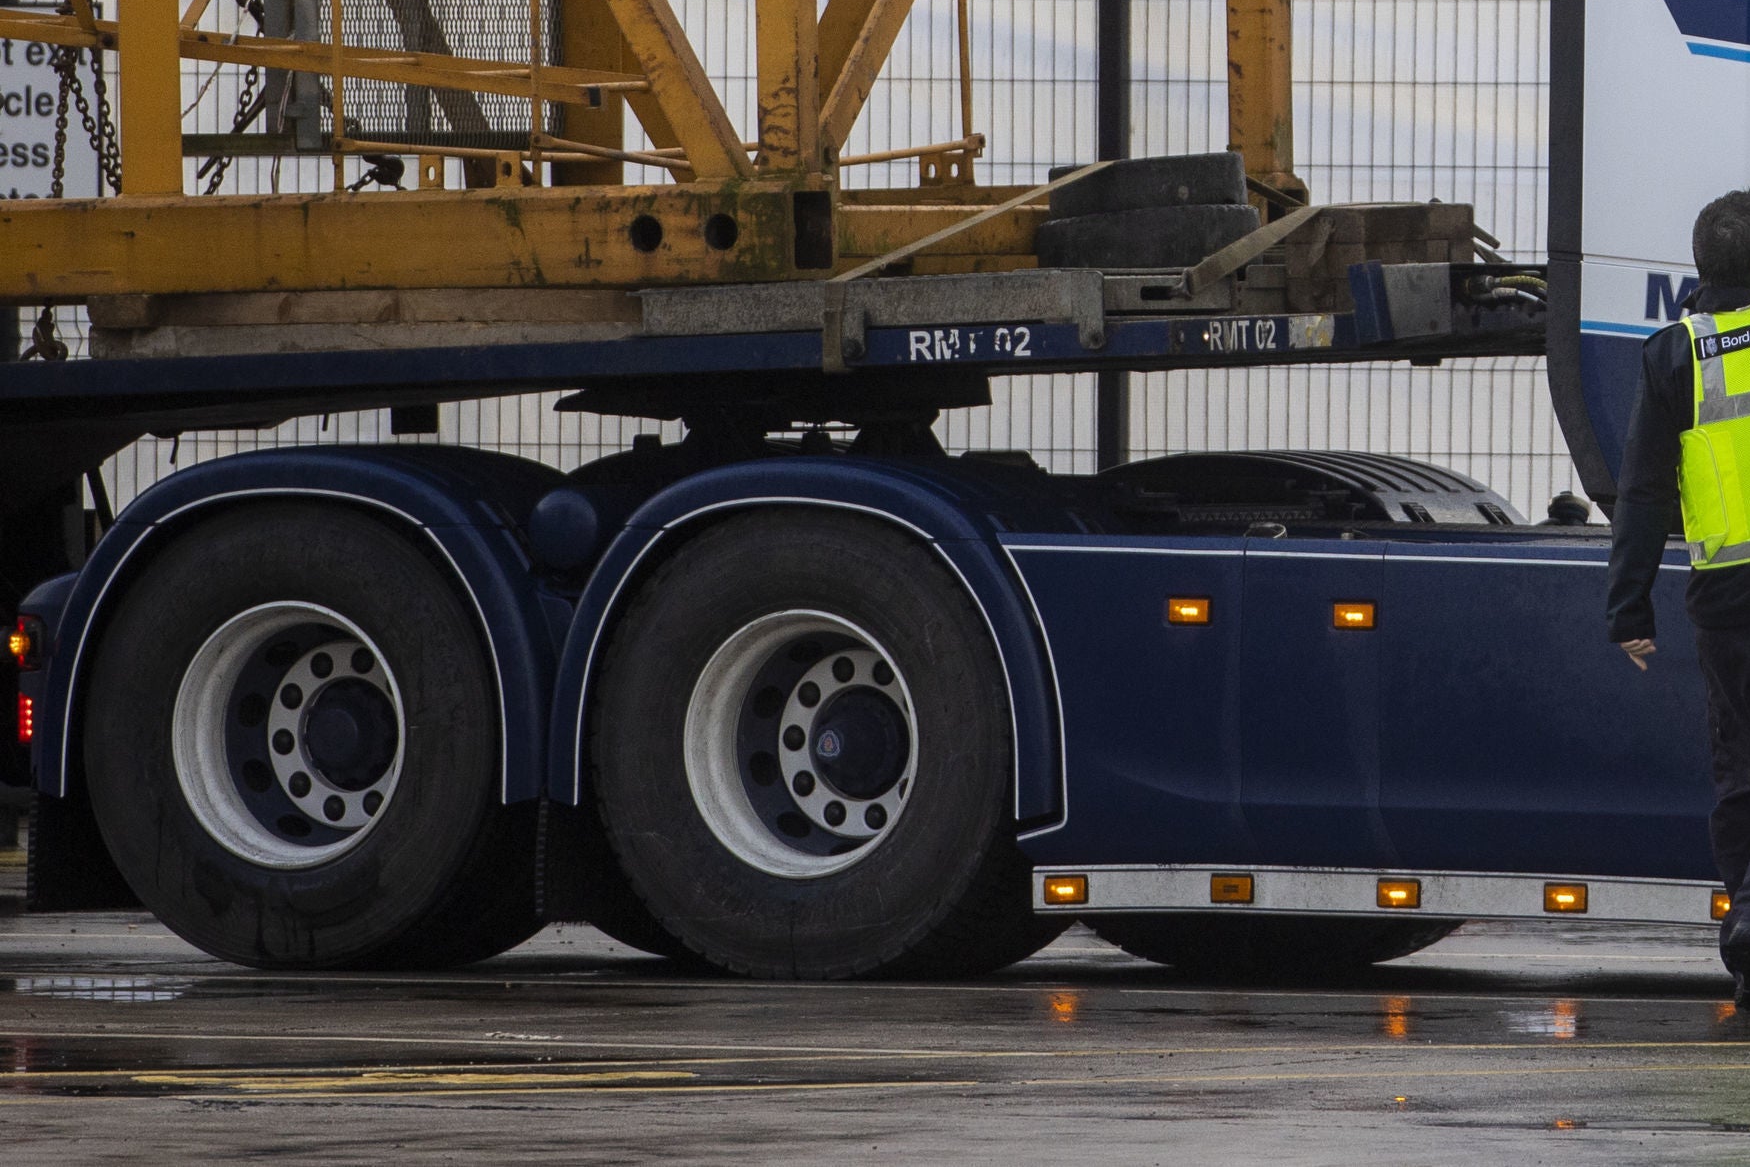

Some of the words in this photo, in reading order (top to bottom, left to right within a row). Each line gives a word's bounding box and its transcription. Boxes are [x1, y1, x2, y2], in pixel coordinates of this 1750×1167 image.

[26, 41, 87, 66] ext
[1, 84, 54, 117] cle
[994, 326, 1032, 357] 02
[1209, 320, 1250, 353] RMT
[1255, 319, 1276, 350] 02
